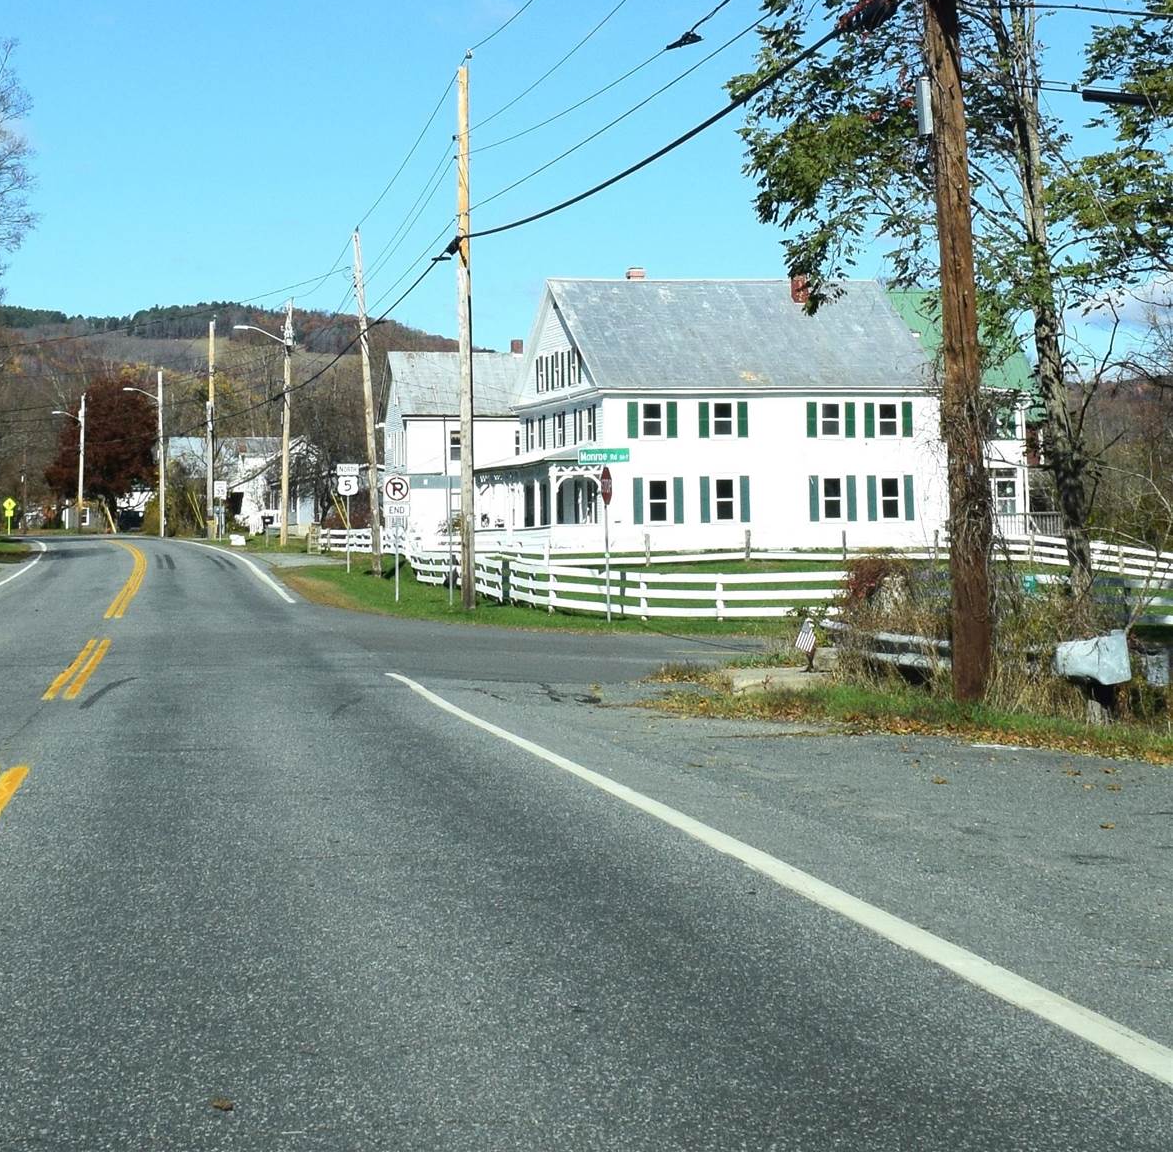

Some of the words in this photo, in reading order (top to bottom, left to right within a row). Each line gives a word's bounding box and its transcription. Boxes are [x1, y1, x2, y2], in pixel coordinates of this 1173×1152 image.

[580, 452, 607, 461] Monroe
[344, 480, 352, 491] 5
[601, 479, 612, 494] STOP
[389, 506, 404, 514] END
